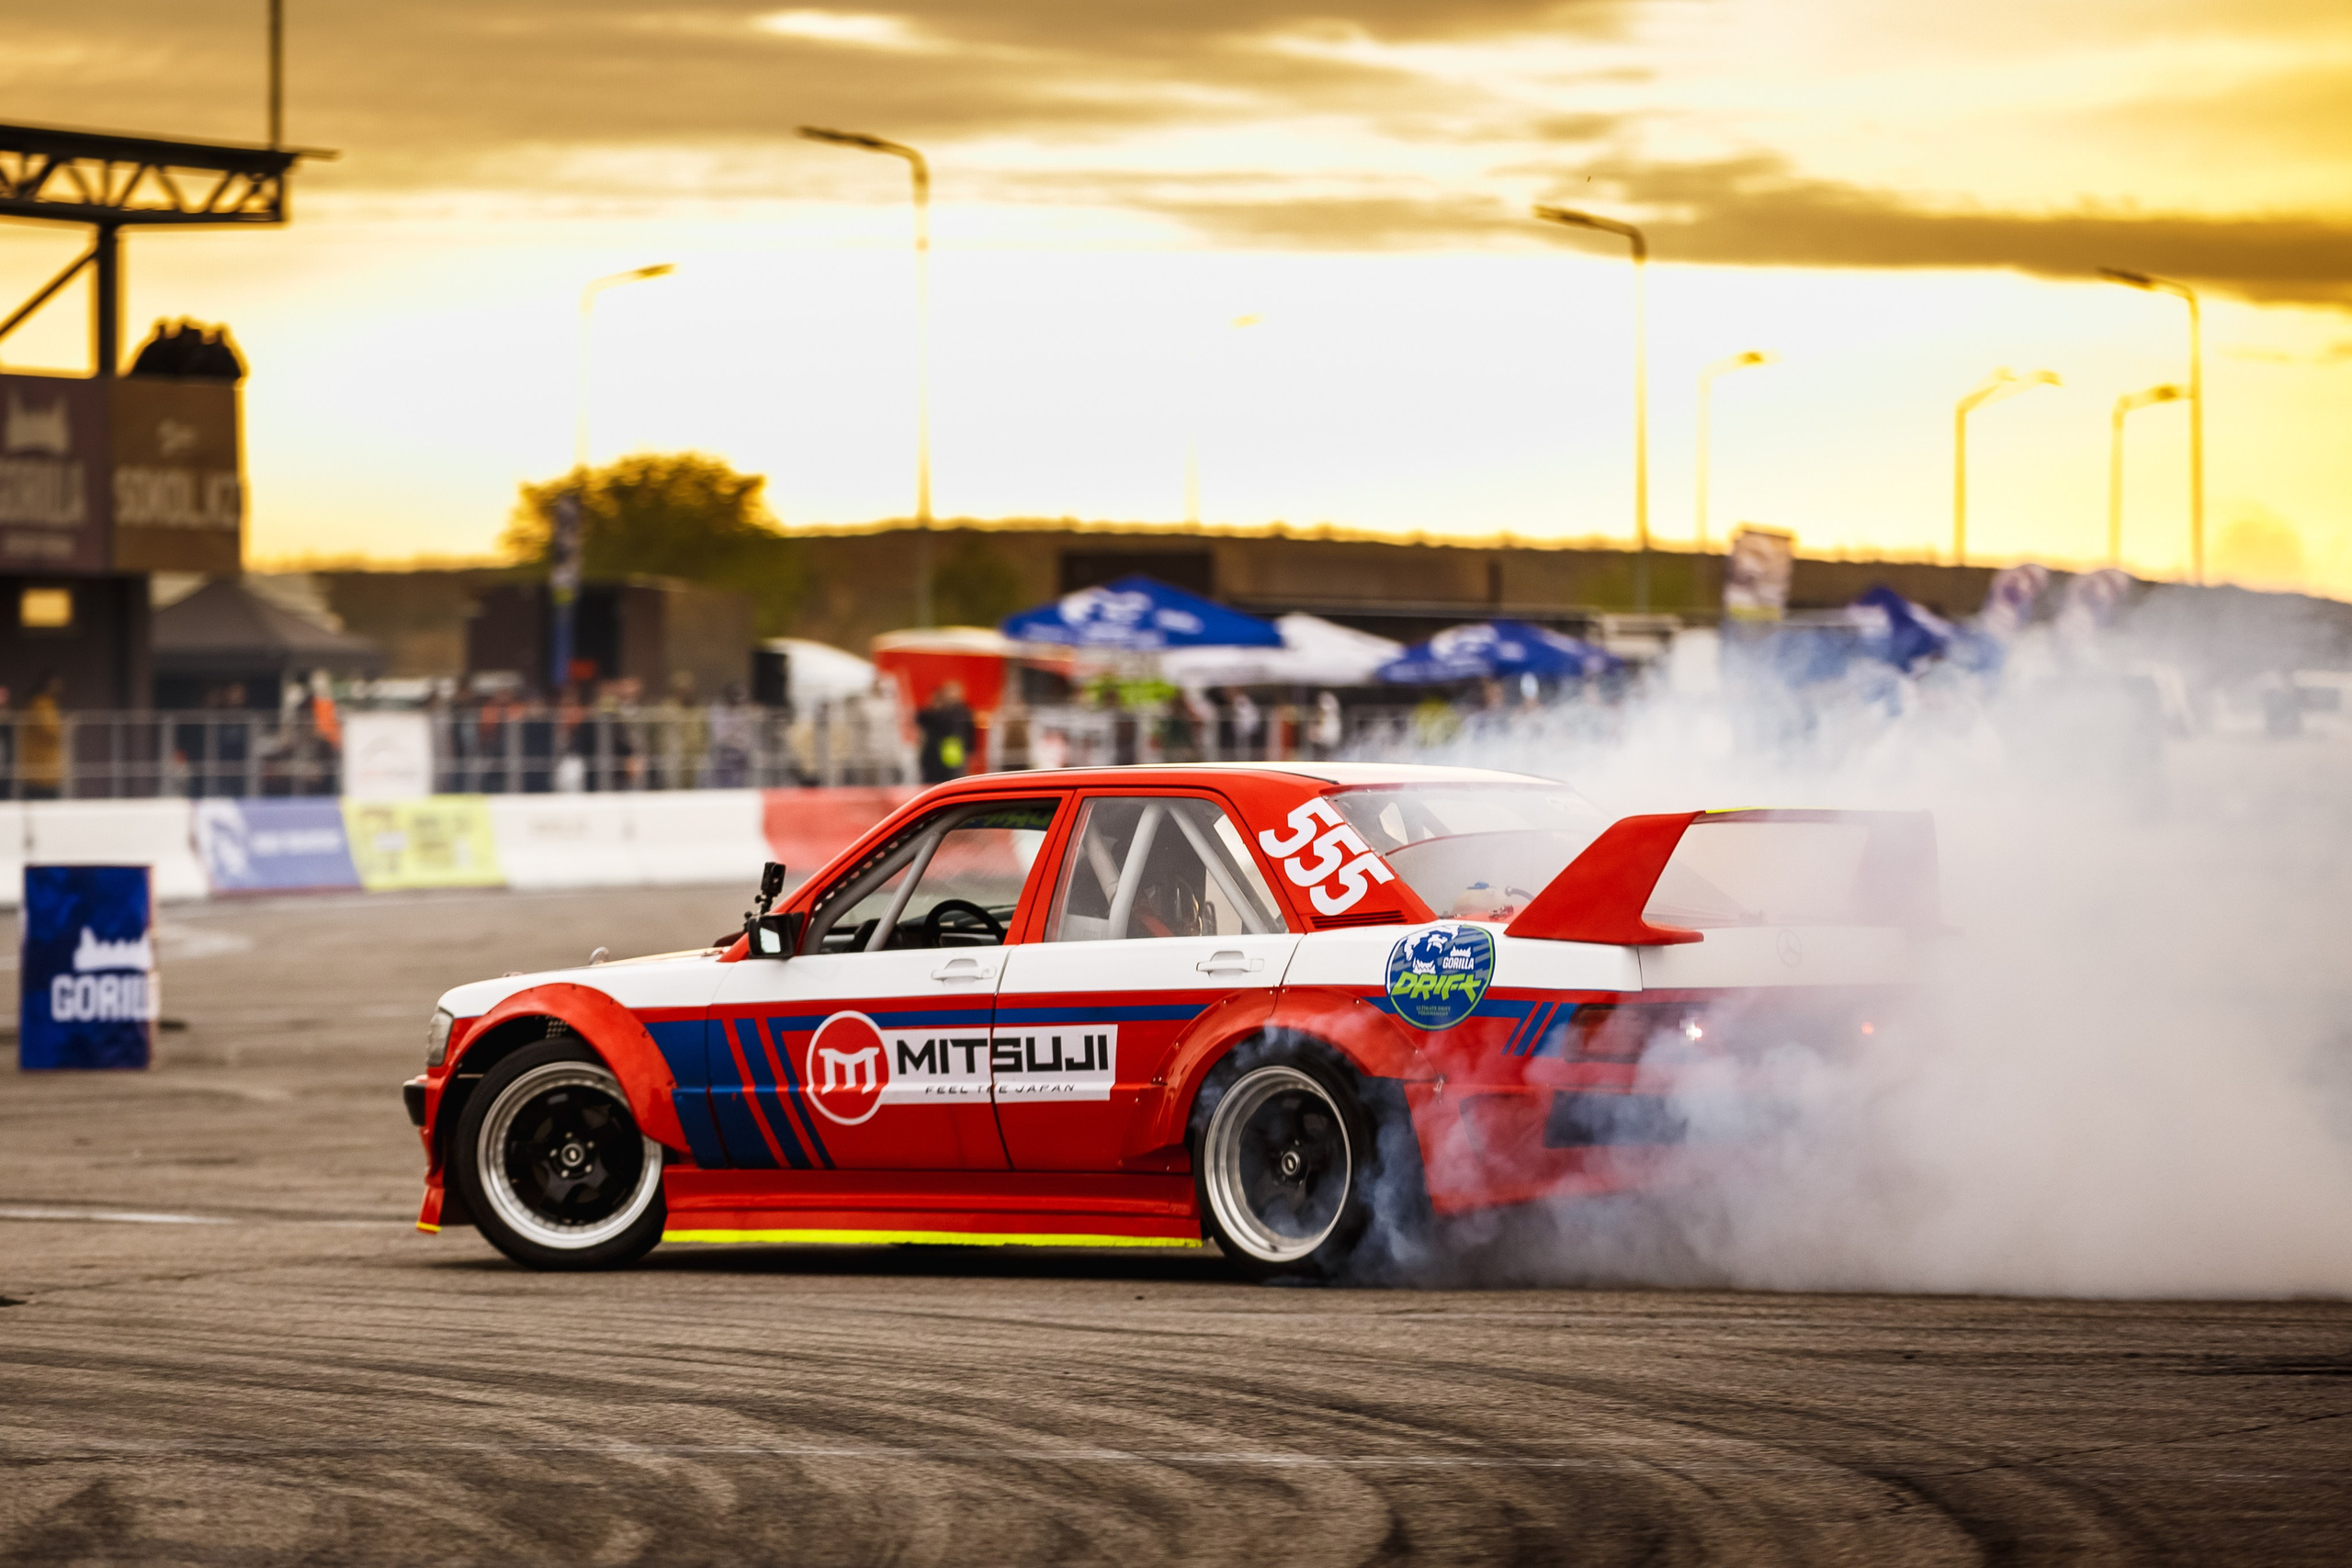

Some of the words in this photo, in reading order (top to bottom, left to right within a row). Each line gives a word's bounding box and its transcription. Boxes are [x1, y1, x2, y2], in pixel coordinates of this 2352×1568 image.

[1258, 795, 1396, 917] 555
[1442, 956, 1475, 970] GORILLA
[1390, 971, 1482, 1004] DRIFT
[897, 1034, 1109, 1075] MITSUJI
[925, 1084, 969, 1095] FEEL
[1015, 1084, 1075, 1094] JAPAN
